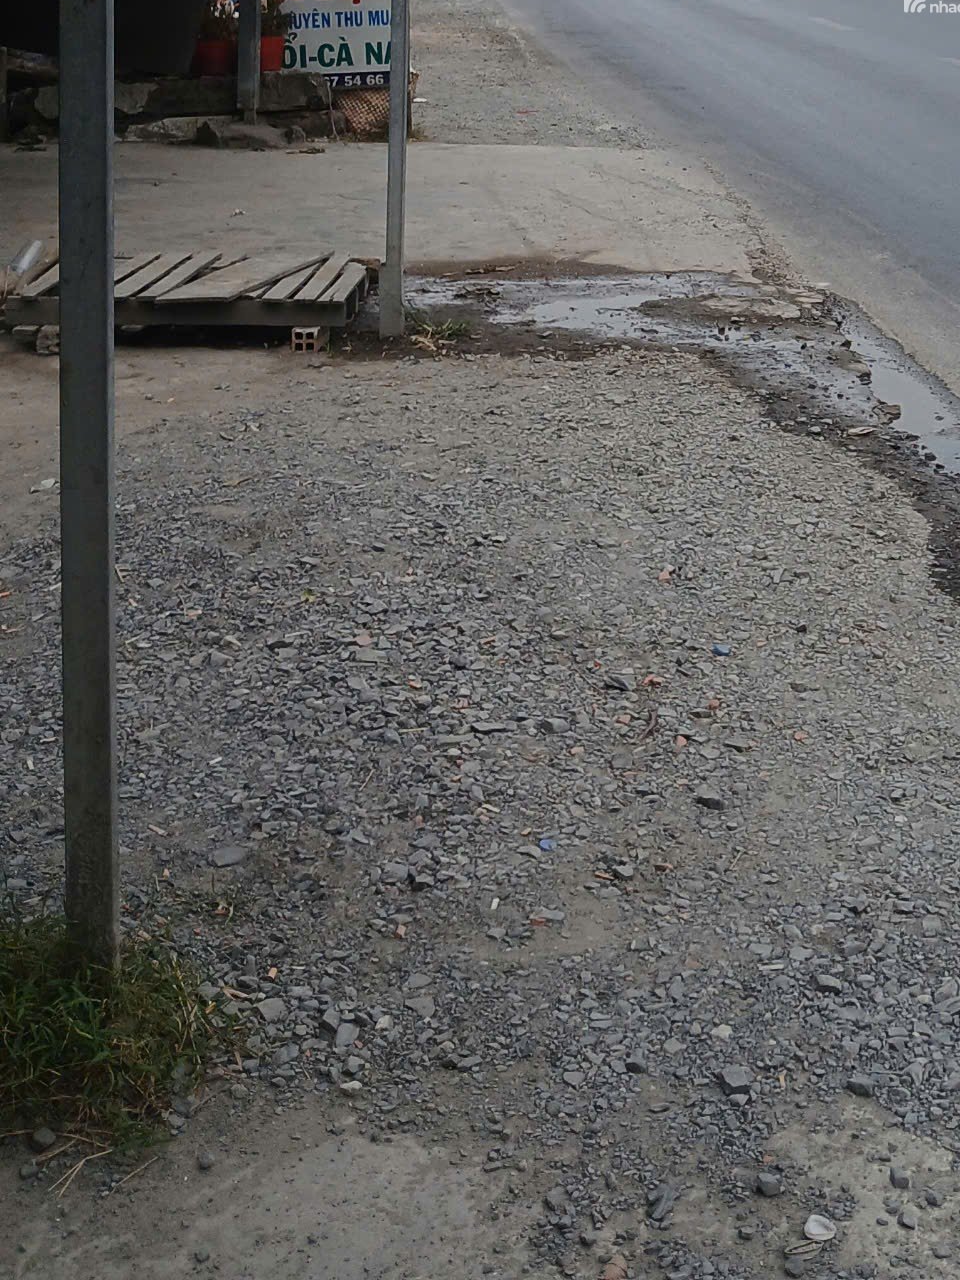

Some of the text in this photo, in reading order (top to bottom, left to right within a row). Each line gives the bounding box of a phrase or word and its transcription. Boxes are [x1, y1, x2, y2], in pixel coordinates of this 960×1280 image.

[335, 10, 363, 28] THU
[368, 9, 391, 26] MU
[344, 76, 361, 87] 54
[366, 74, 384, 86] 66
